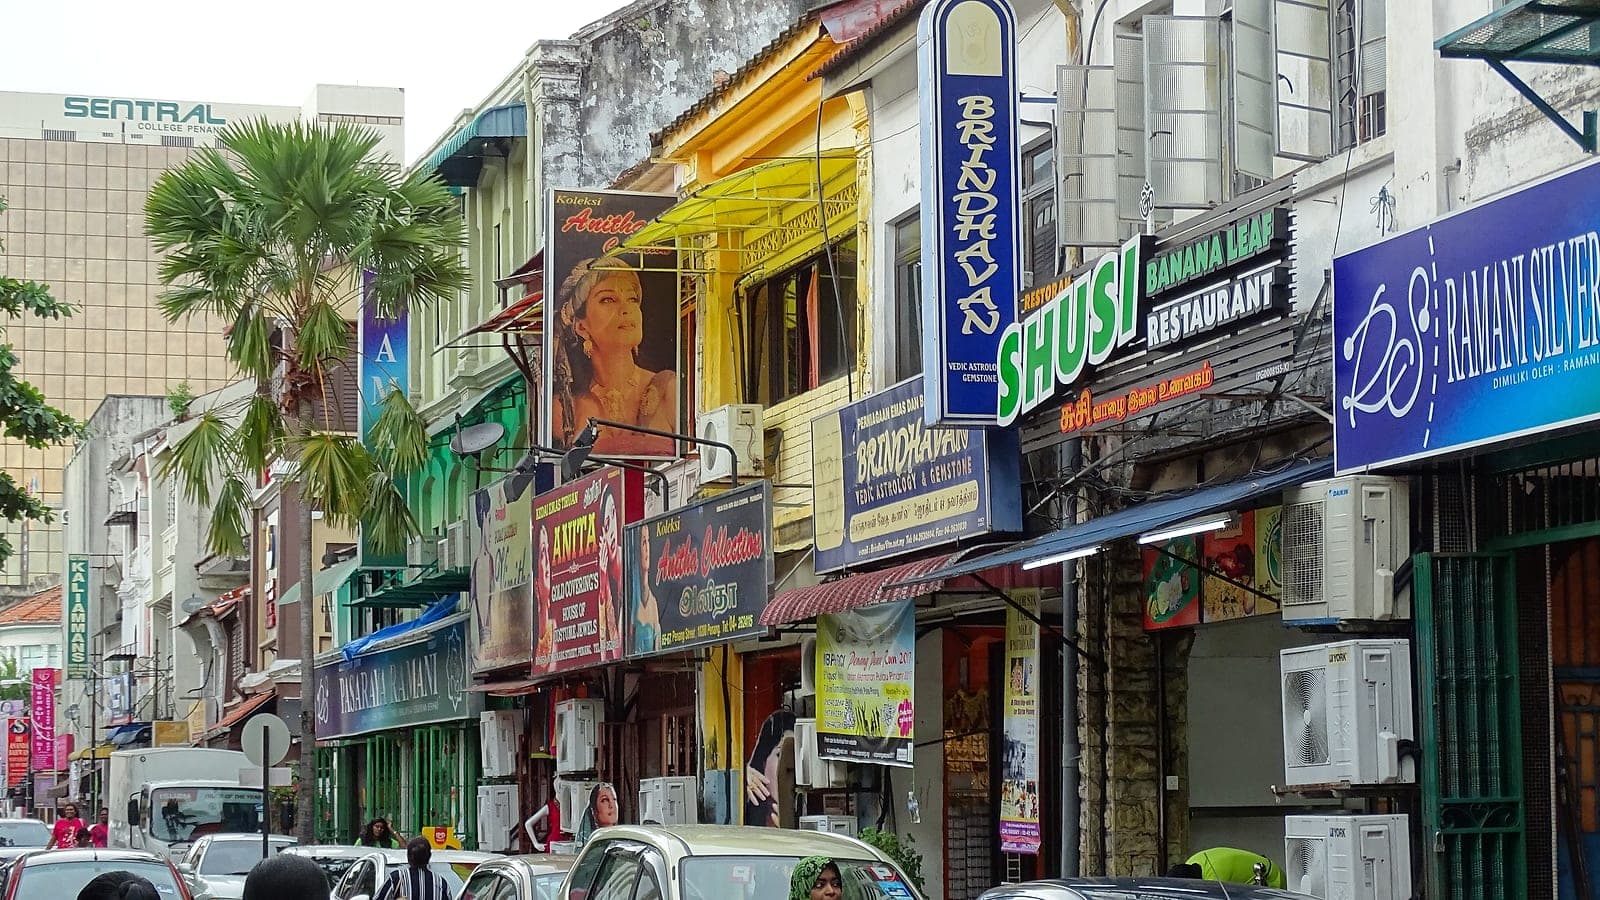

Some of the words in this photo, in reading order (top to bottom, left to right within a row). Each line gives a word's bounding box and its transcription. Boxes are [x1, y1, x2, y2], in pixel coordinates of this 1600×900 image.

[64, 97, 226, 125] SENTRAL
[138, 122, 183, 133] COLLEGE
[556, 195, 602, 206] Koleksi
[953, 96, 1000, 336] BRINDHAVAN
[1146, 236, 1224, 297] BANANA
[1227, 211, 1274, 262] LEAF
[997, 233, 1141, 427] SHUSI
[1147, 271, 1274, 350] RESTAURANT
[1445, 253, 1529, 384] RAMANI
[949, 362, 968, 371] VEDIC
[963, 374, 998, 383] GEMSTONE
[1493, 370, 1529, 390] DIMILIKI
[1531, 363, 1554, 380] OLEH
[1563, 351, 1600, 373] RAMANI
[890, 400, 907, 418] EMAS
[907, 395, 920, 412] DAN
[857, 417, 969, 484] BRINDHAVAN
[855, 485, 875, 506] VEDIC
[876, 473, 917, 498] ASTROLOGY
[931, 456, 972, 484] GEMSTONE
[552, 512, 597, 564] ANITA
[656, 515, 681, 538] Koleksi
[656, 533, 699, 586] Anitha
[700, 523, 763, 579] Collection
[71, 562, 86, 662] KALIAMMANS
[551, 582, 565, 602] GOLD
[562, 603, 579, 622] HOUSE
[579, 602, 587, 617] OF
[679, 578, 738, 619] அனிதா
[1334, 653, 1347, 662] YORK
[339, 664, 387, 714] PASARAYA
[389, 653, 439, 703] RAMANI
